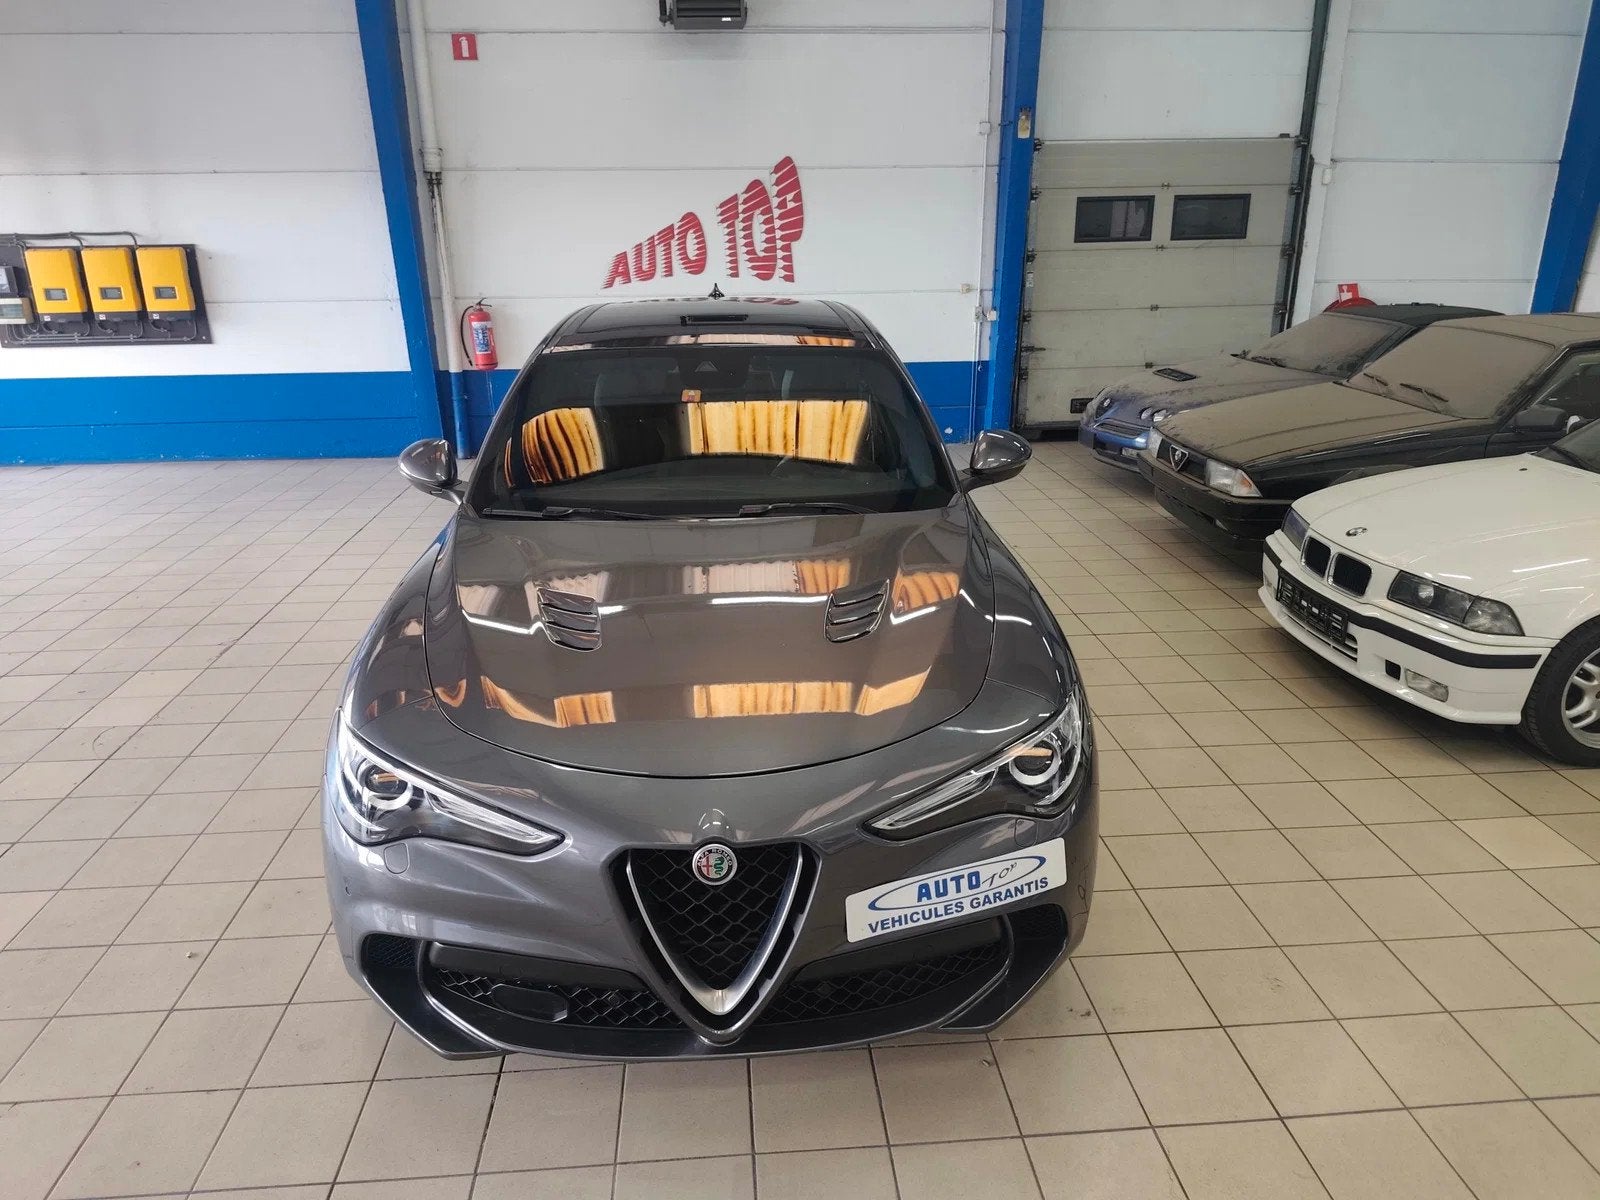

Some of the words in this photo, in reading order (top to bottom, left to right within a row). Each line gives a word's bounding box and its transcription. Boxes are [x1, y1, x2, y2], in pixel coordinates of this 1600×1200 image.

[601, 212, 707, 289] AUTO
[716, 156, 804, 283] TOP
[868, 900, 965, 934] VEHICULES
[969, 876, 1049, 910] GARANTIS
[917, 870, 981, 903] AUTO
